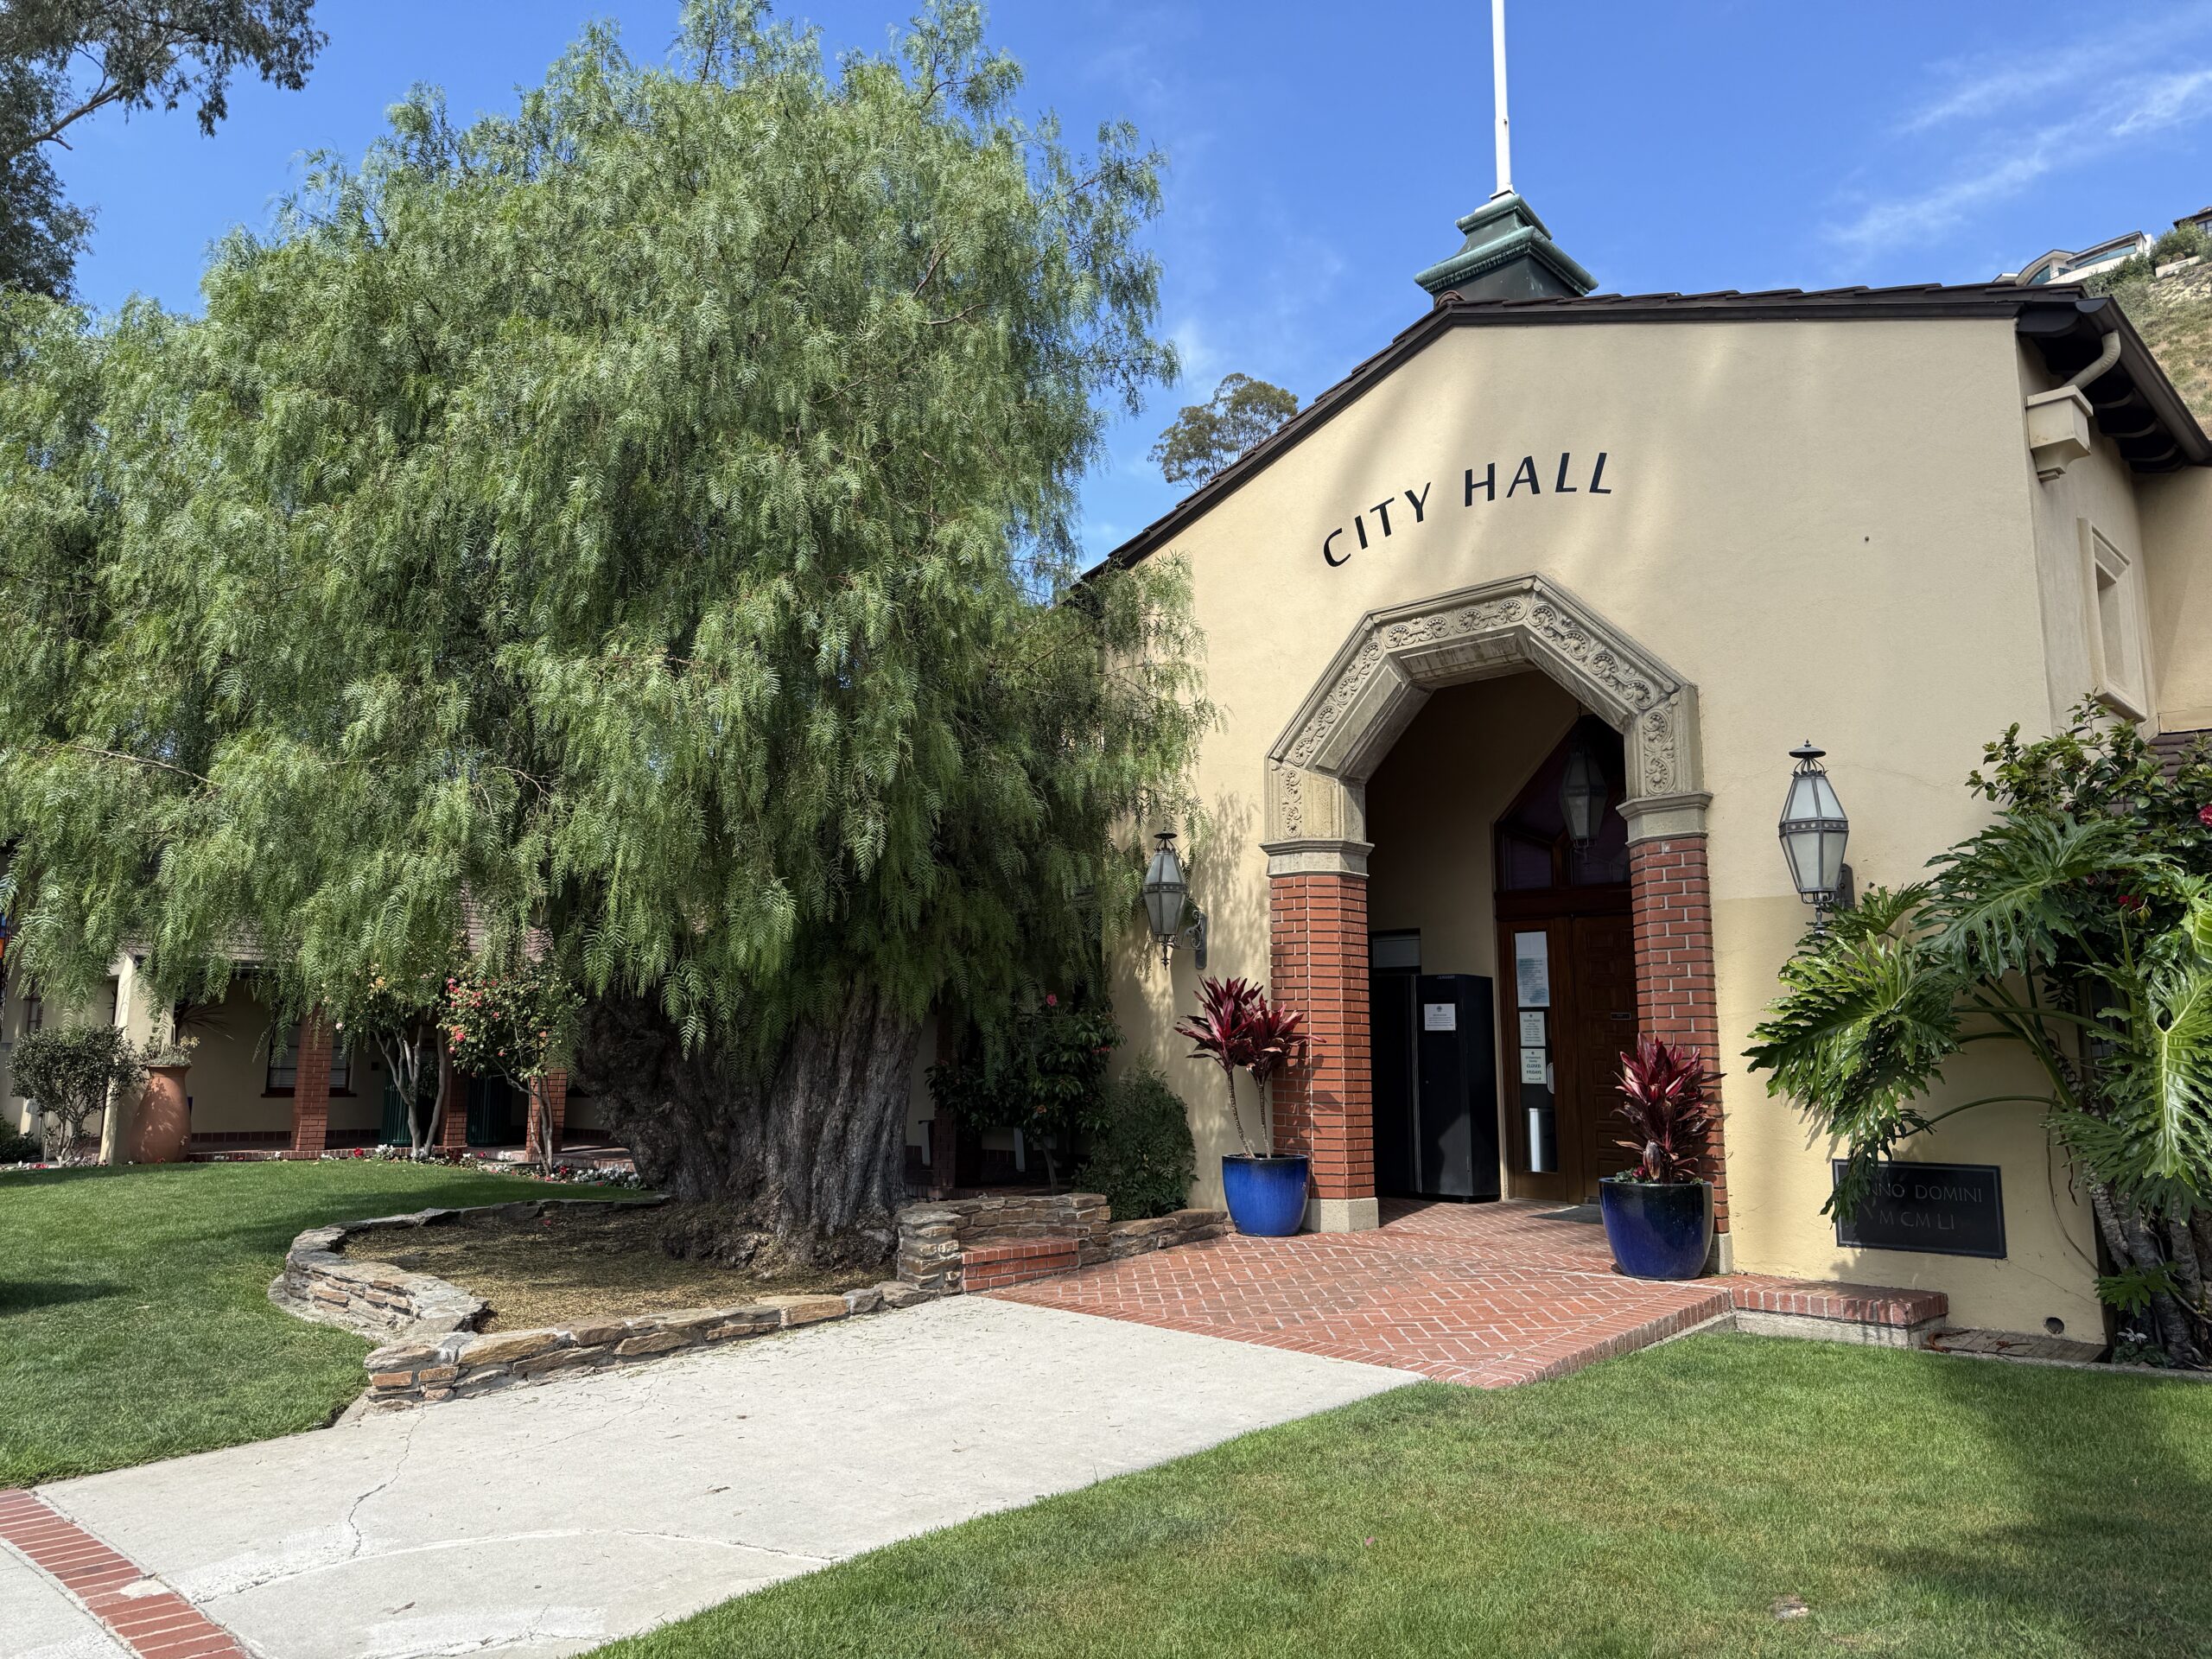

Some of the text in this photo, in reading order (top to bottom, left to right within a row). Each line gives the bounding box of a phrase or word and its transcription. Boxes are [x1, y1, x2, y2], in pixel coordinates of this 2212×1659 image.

[1323, 452, 1612, 568] CITY HALL
[1872, 1183, 1982, 1203] NNO DOMINI
